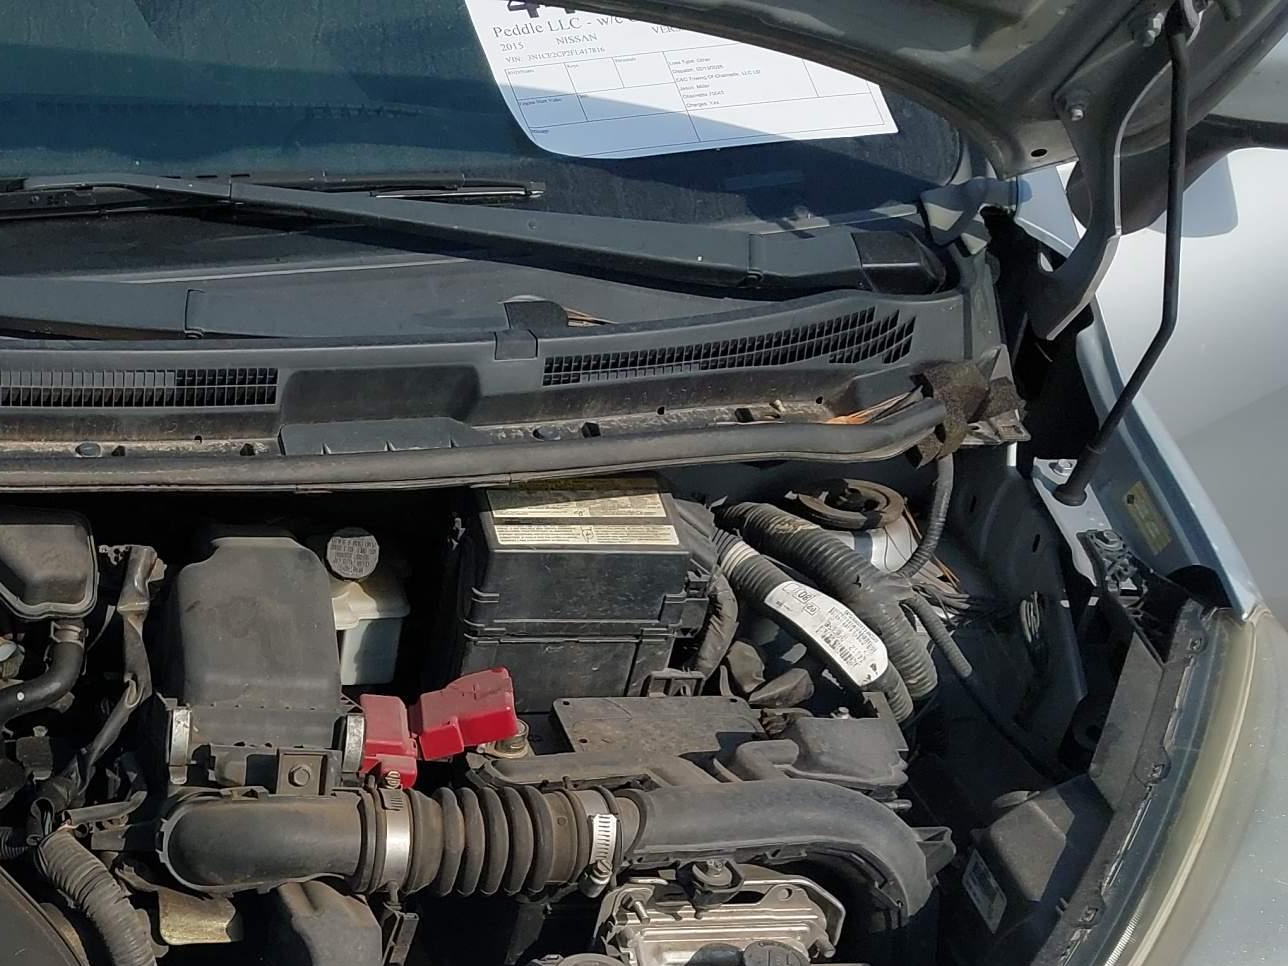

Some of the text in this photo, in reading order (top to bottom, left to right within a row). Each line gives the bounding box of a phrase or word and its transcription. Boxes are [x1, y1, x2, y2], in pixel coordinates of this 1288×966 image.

[492, 23, 544, 38] Peddle
[547, 17, 582, 32] LLC
[500, 42, 524, 52] 2015
[555, 33, 598, 46] NISSAN
